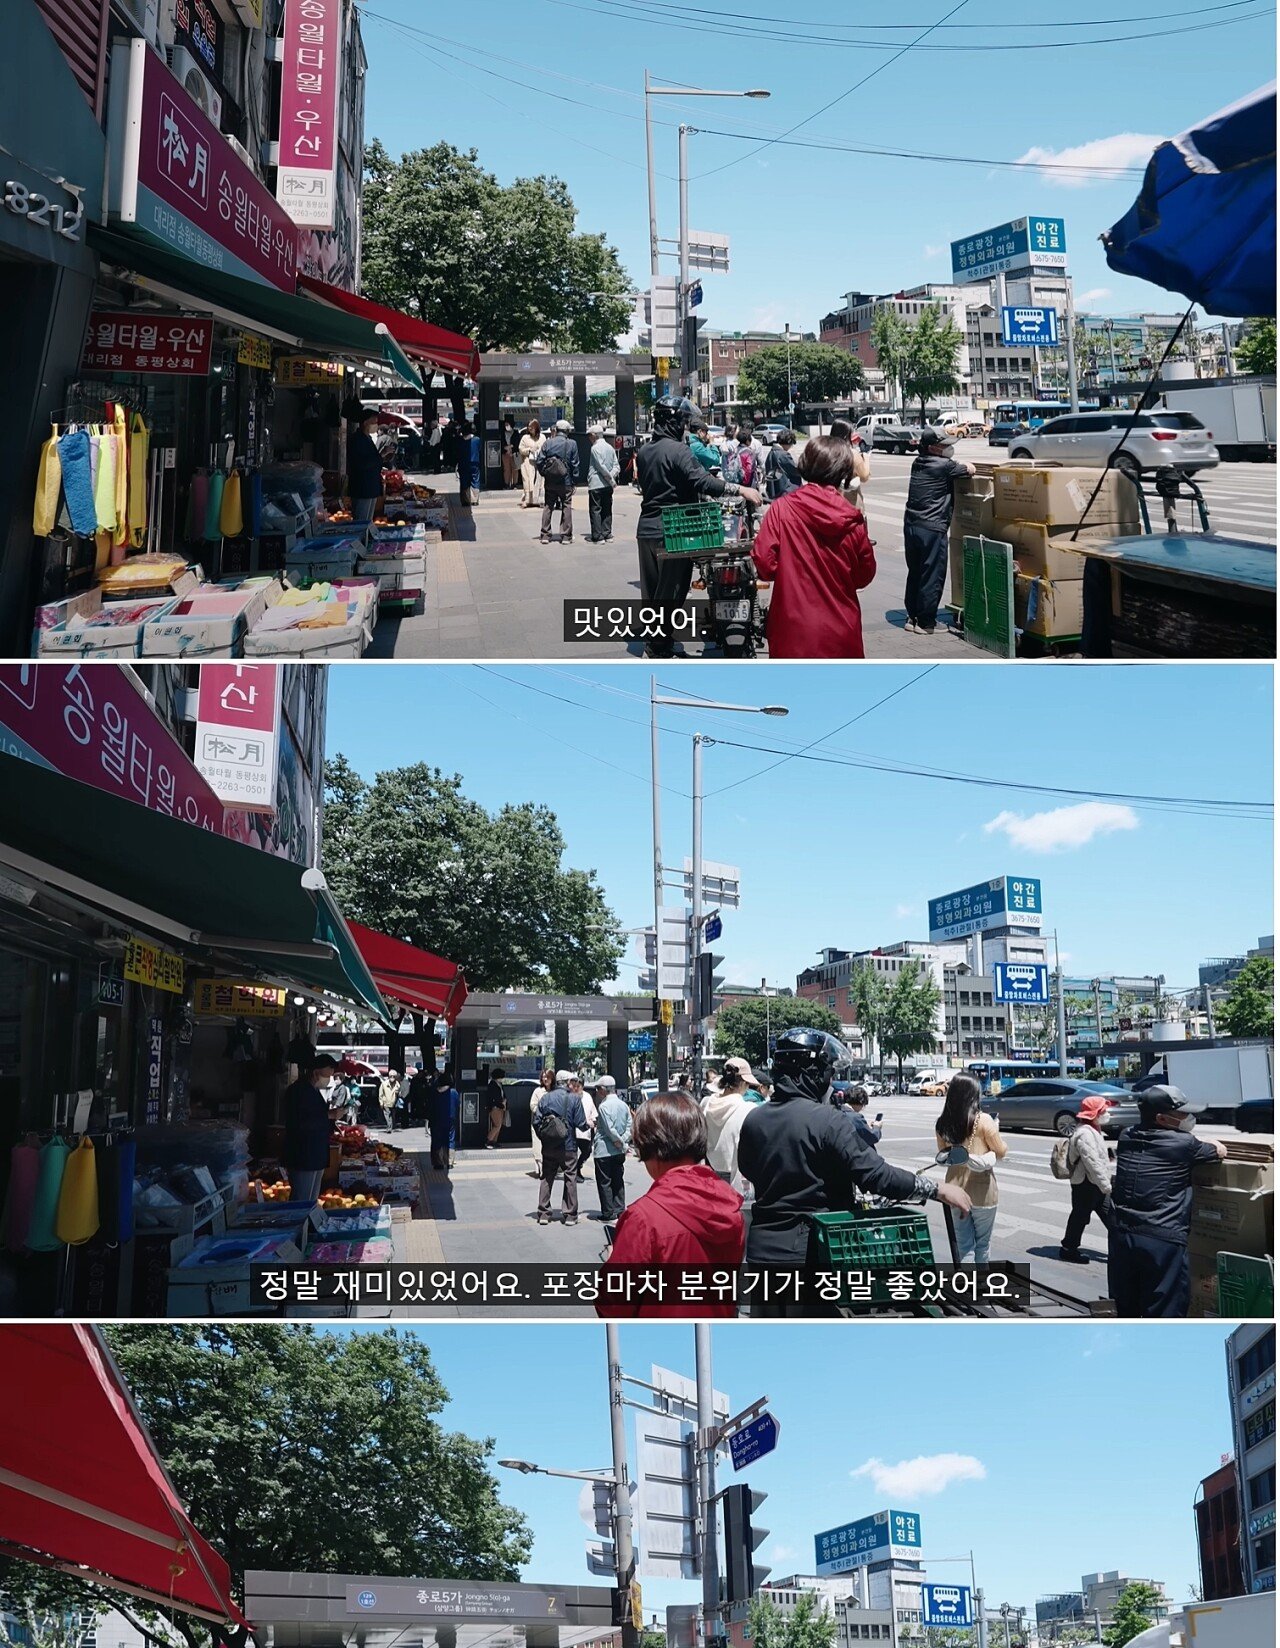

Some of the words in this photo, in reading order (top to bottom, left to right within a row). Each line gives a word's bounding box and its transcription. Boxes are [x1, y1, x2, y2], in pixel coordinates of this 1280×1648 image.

[162, 107, 209, 199] 松月
[286, 177, 325, 195] 松月
[217, 169, 294, 279] 송월타월·우산
[1035, 222, 1059, 235] 야간
[1036, 235, 1060, 249] 진료
[1034, 254, 1065, 264] 3675-7650
[723, 608, 748, 619] 1015
[207, 737, 261, 763] 松月
[235, 769, 267, 782] 동평상회
[1012, 882, 1036, 896] 야간
[935, 893, 971, 914] 종로광장
[1013, 895, 1036, 909] 진료
[1010, 914, 1040, 924] 3675-7650
[214, 984, 280, 1008] 철학원
[149, 1034, 162, 1088] 직업
[731, 1428, 752, 1449] 동호로
[895, 1516, 916, 1530] 야간
[821, 1528, 857, 1549] 종로광장
[896, 1530, 916, 1543] 진료
[894, 1547, 921, 1558] 3675-7650
[416, 1590, 463, 1604] 종로5가
[464, 1593, 488, 1602] Jongno
[548, 1597, 556, 1608] 7
[434, 1604, 463, 1613] (삼양그룹)
